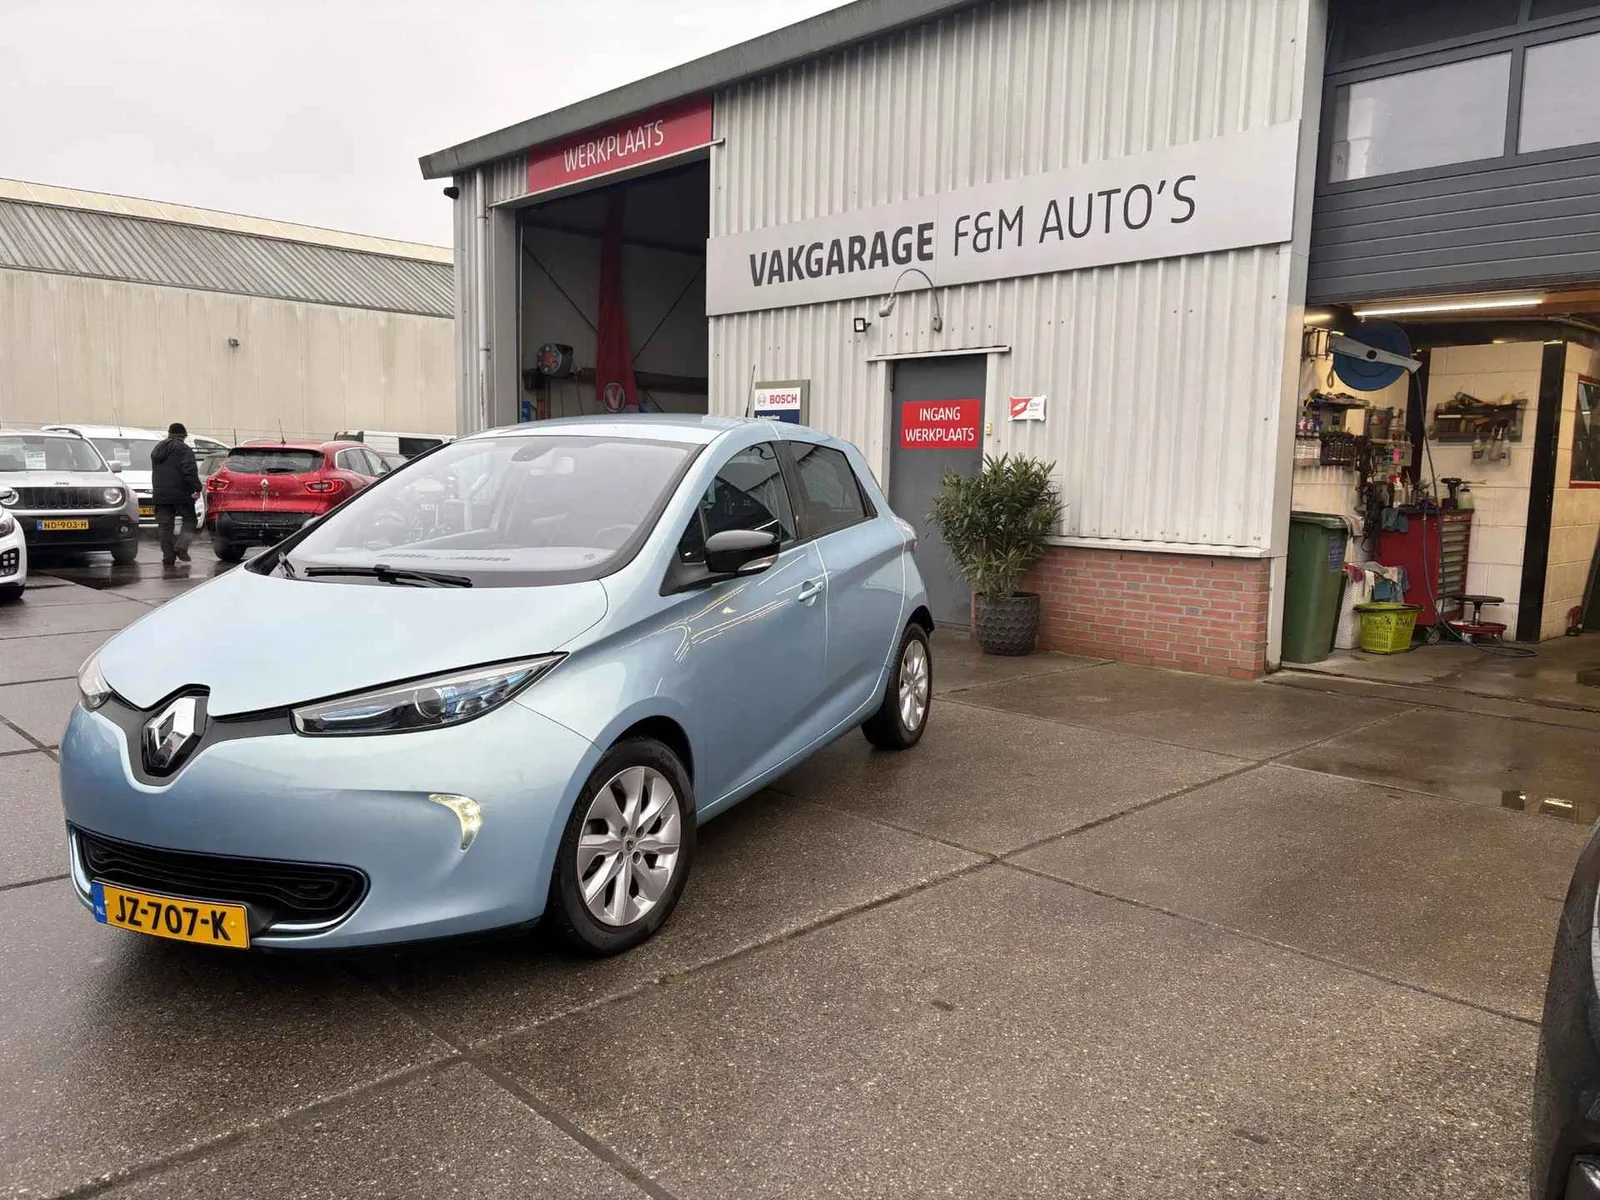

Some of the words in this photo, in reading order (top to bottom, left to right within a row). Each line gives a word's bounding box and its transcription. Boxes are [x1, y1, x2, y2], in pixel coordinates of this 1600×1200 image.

[564, 120, 665, 173] WERKPLAATS
[749, 221, 934, 287] VAKGARAGE
[953, 205, 1024, 256] F&M
[1039, 174, 1196, 242] AUTO'S
[769, 394, 798, 404] BOSCH
[919, 406, 960, 422] INGANG
[904, 426, 975, 443] WERKPLAATS
[115, 894, 231, 941] JZ-707-K
